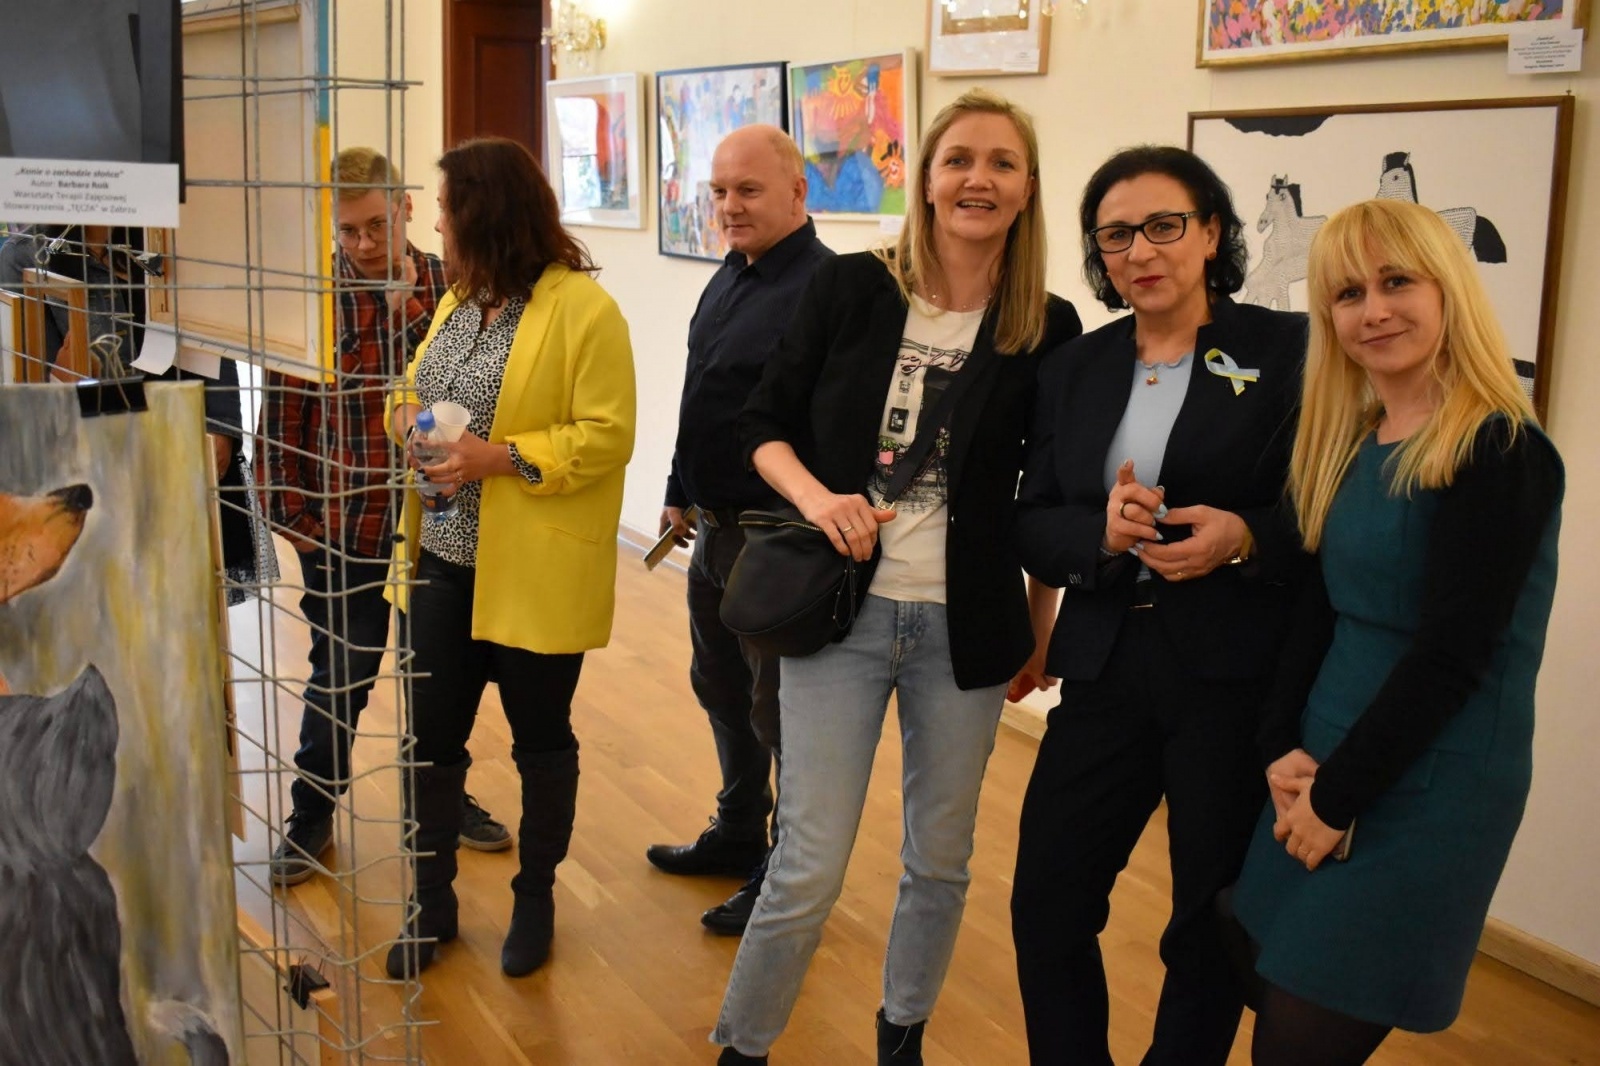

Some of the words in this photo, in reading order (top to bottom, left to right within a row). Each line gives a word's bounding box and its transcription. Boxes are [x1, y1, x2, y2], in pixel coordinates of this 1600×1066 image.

[58, 180, 90, 189] Barbara
[13, 190, 54, 200] Warsztaty
[55, 191, 82, 201] Terapii
[3, 201, 65, 212] Stowarzyszenia
